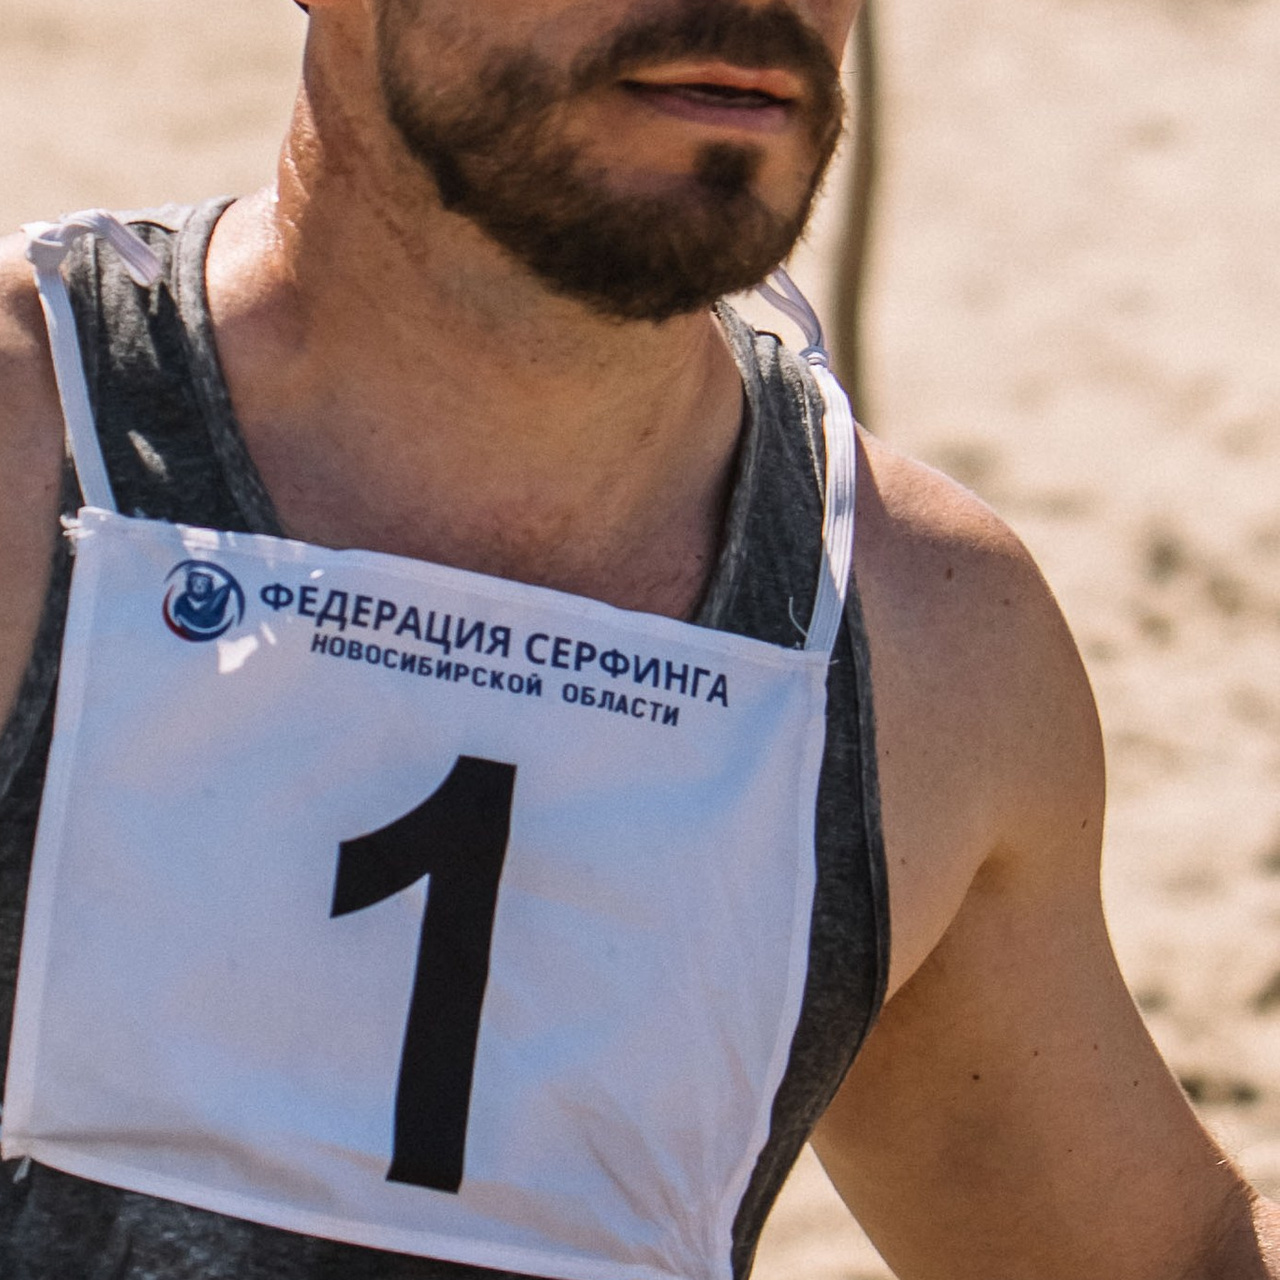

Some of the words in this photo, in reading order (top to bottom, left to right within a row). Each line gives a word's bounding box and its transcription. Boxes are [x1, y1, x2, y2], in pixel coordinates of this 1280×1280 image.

[259, 582, 512, 659] ФЕДЕРАЦИЯ
[523, 632, 730, 708] СЕРФИНГА
[310, 633, 543, 698] НОВОСИБИРСКОЙ
[561, 682, 680, 727] ОБЛАСТИ
[328, 753, 518, 1196] 1
